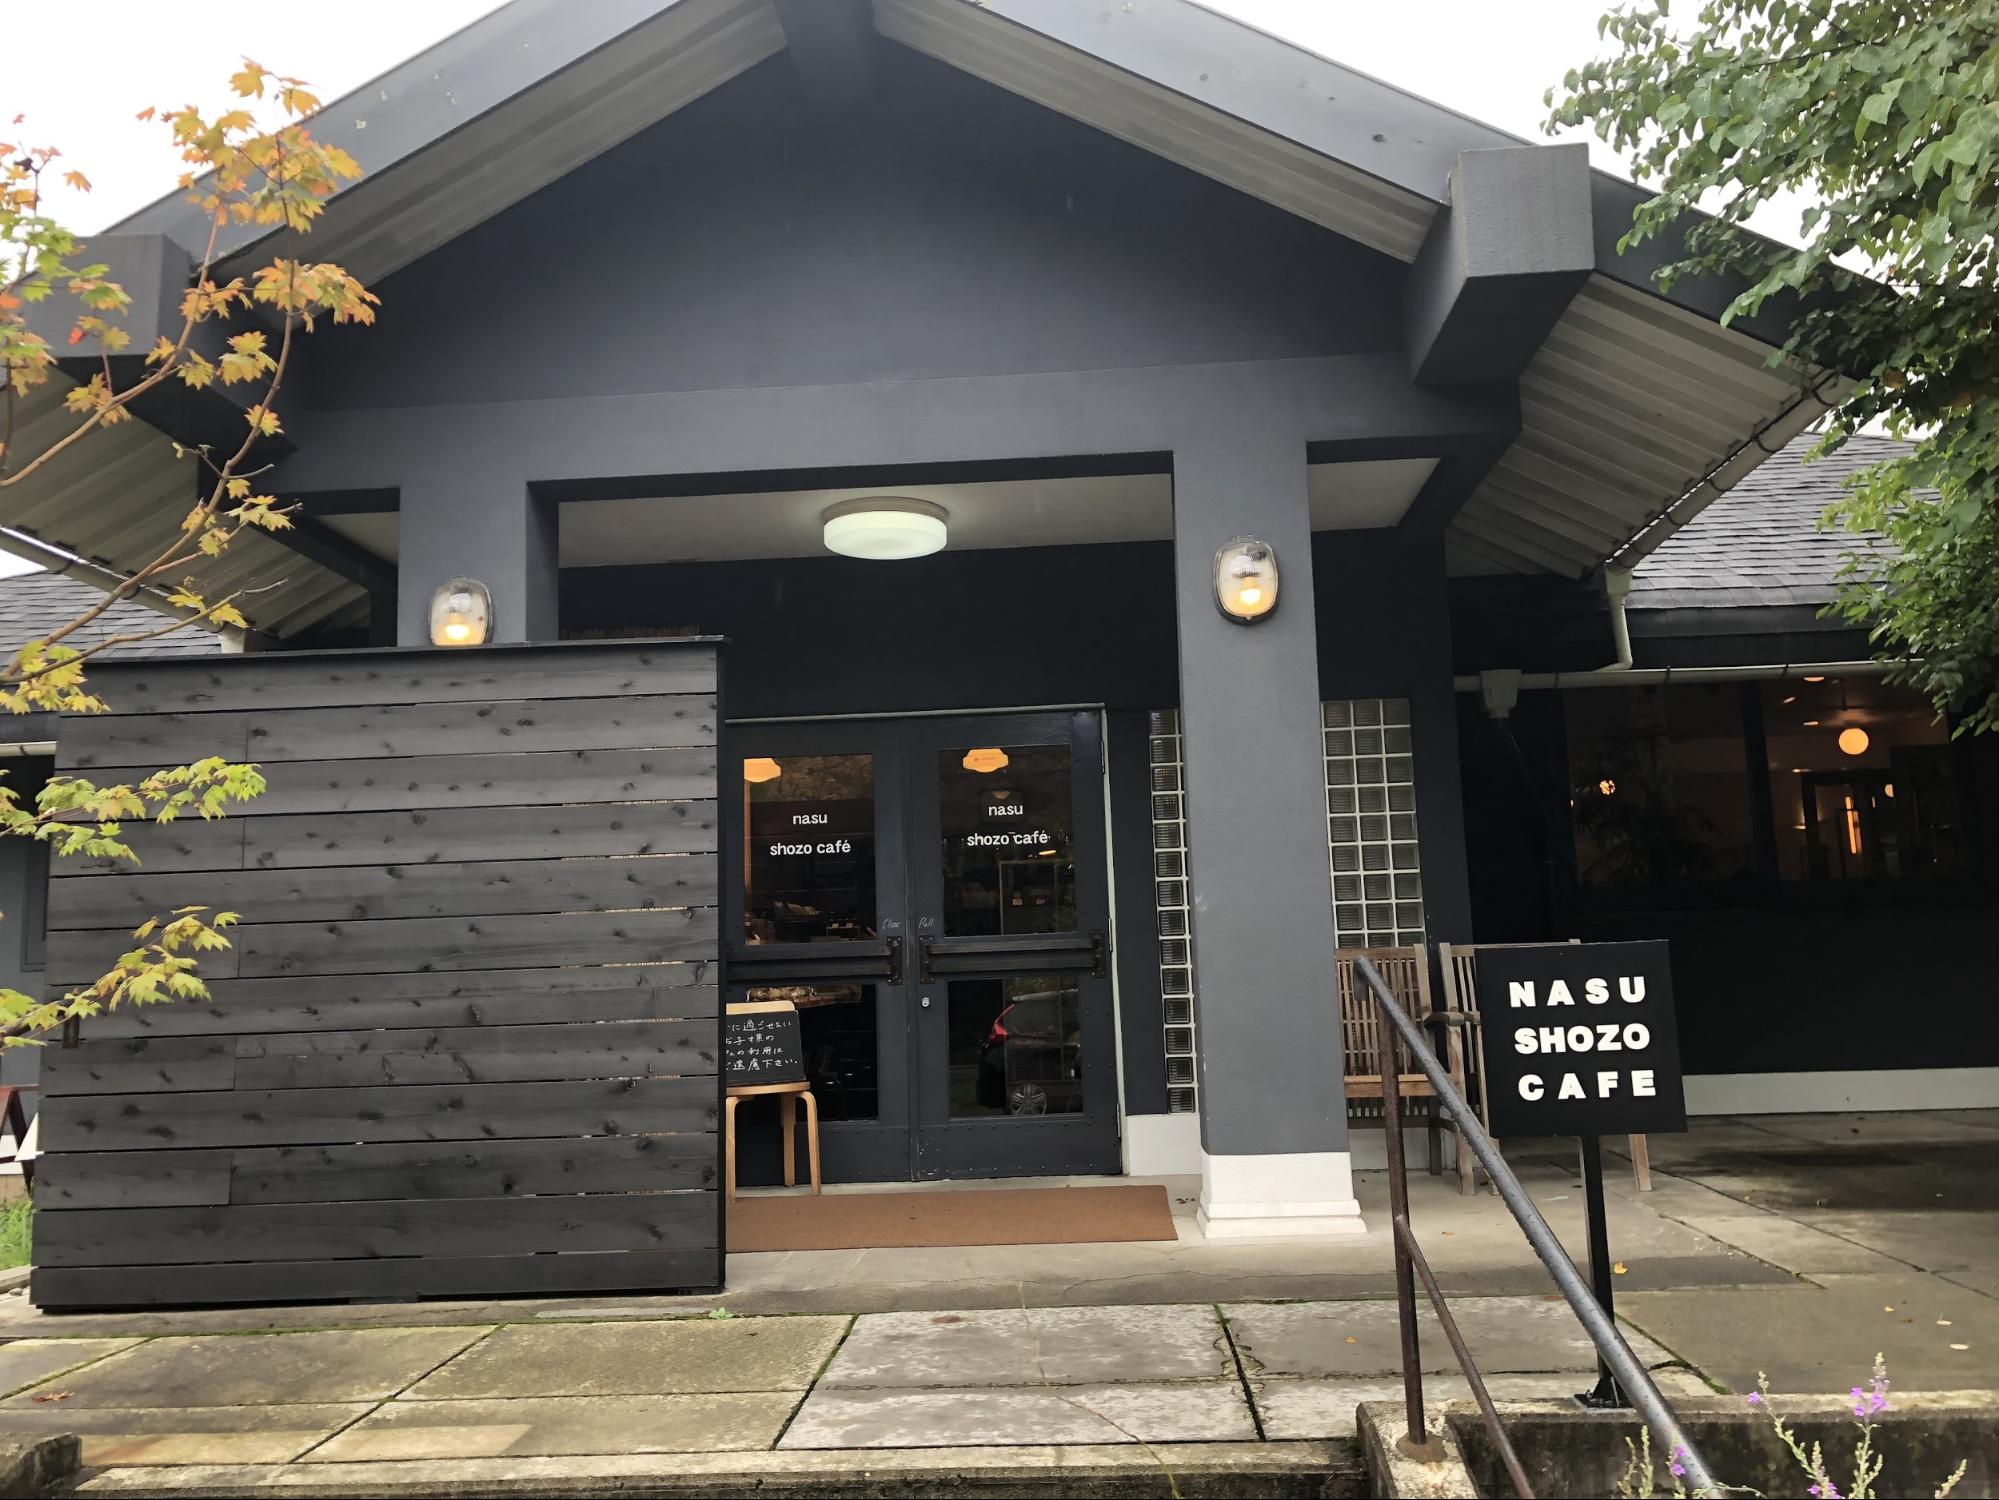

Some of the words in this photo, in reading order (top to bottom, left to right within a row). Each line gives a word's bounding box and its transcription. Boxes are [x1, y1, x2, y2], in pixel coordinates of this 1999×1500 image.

[988, 802, 1024, 817] nasu
[792, 811, 828, 826] nasu
[967, 831, 1010, 847] shozo
[1014, 829, 1048, 845] café
[769, 841, 813, 856] shozo
[816, 839, 851, 855] café
[1508, 976, 1646, 1008] NASU
[727, 1018, 792, 1032] に過ごせない
[1514, 1023, 1651, 1055] SHOZO
[1518, 1069, 1657, 1102] CAFE
